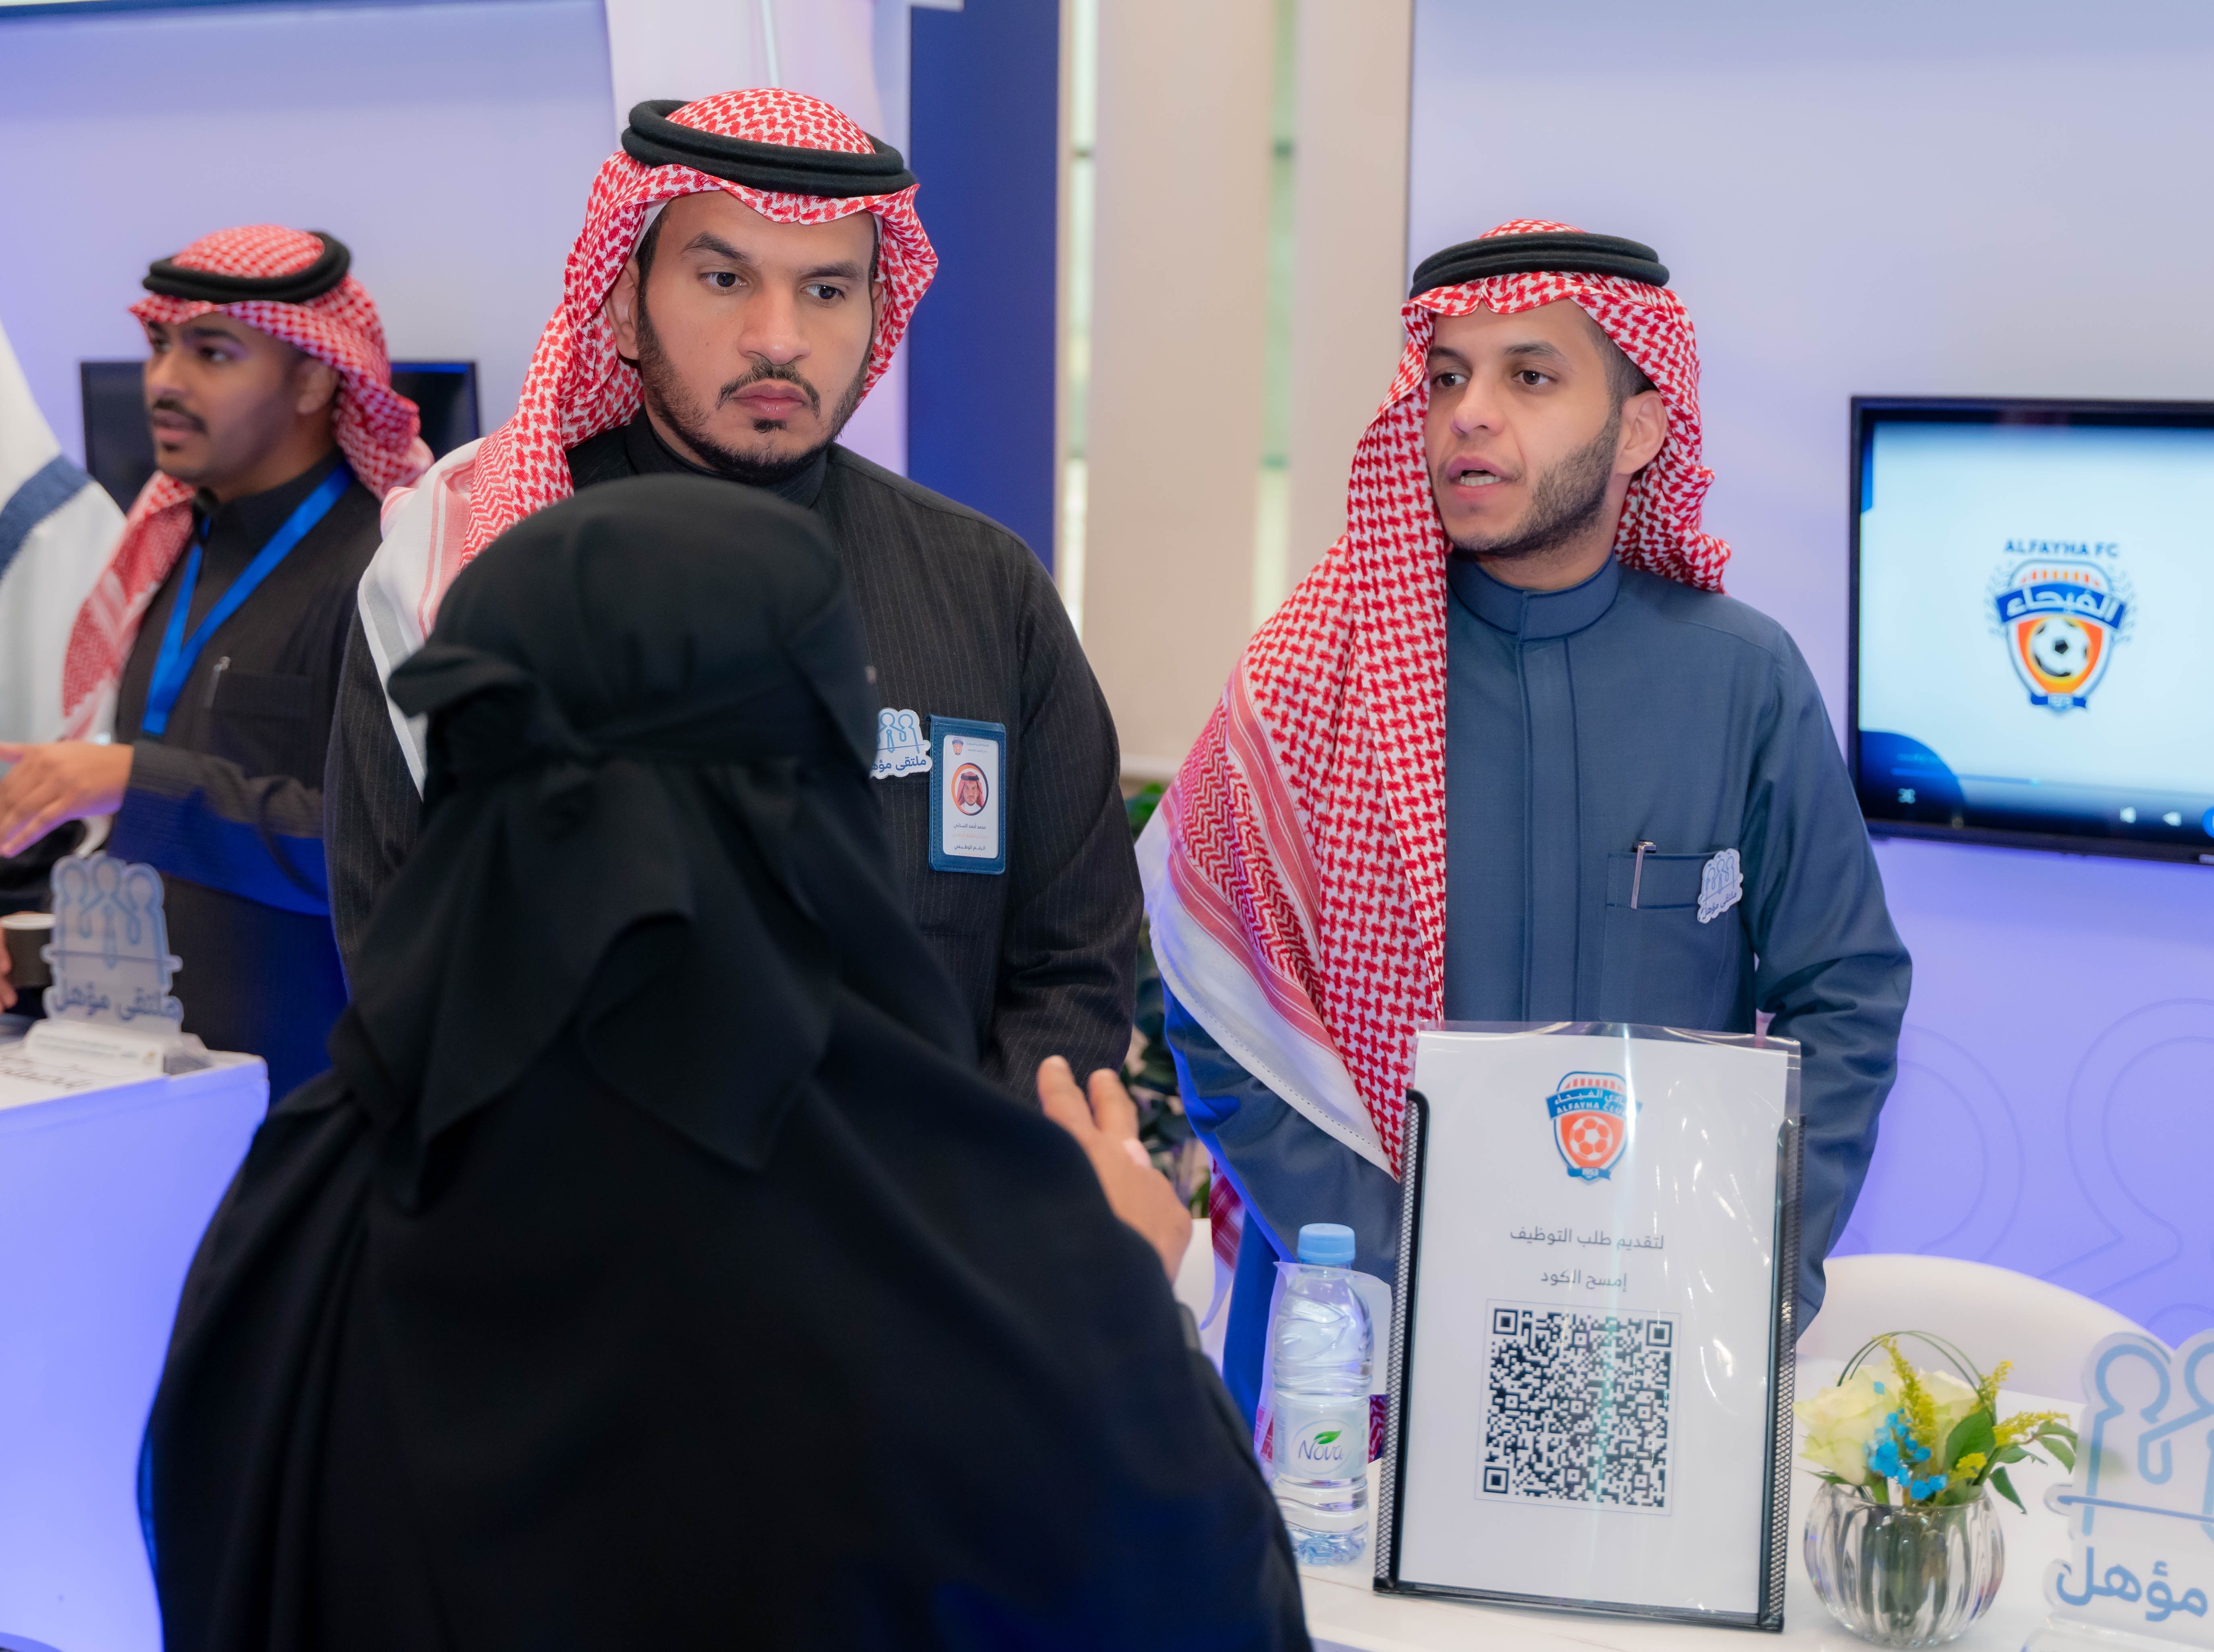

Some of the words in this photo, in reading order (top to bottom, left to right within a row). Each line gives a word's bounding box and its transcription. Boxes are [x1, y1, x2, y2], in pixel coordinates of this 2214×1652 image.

[2004, 539, 2088, 554] ALFAYHA
[2095, 541, 2118, 557] FC
[2006, 588, 2123, 622] الفيحاء
[871, 759, 892, 773] مؤه
[896, 756, 926, 771] ملتقى
[1557, 1102, 1600, 1114] ALFAYHA
[1510, 1226, 1572, 1245] التوظيف
[1578, 1230, 1611, 1247] طلب
[1617, 1235, 1664, 1251] لتقديم
[1541, 1269, 1581, 1286] الكود
[1586, 1273, 1627, 1292] إمسح
[1298, 1440, 1343, 1461] Nova
[2056, 1546, 2208, 1622] مؤهل
